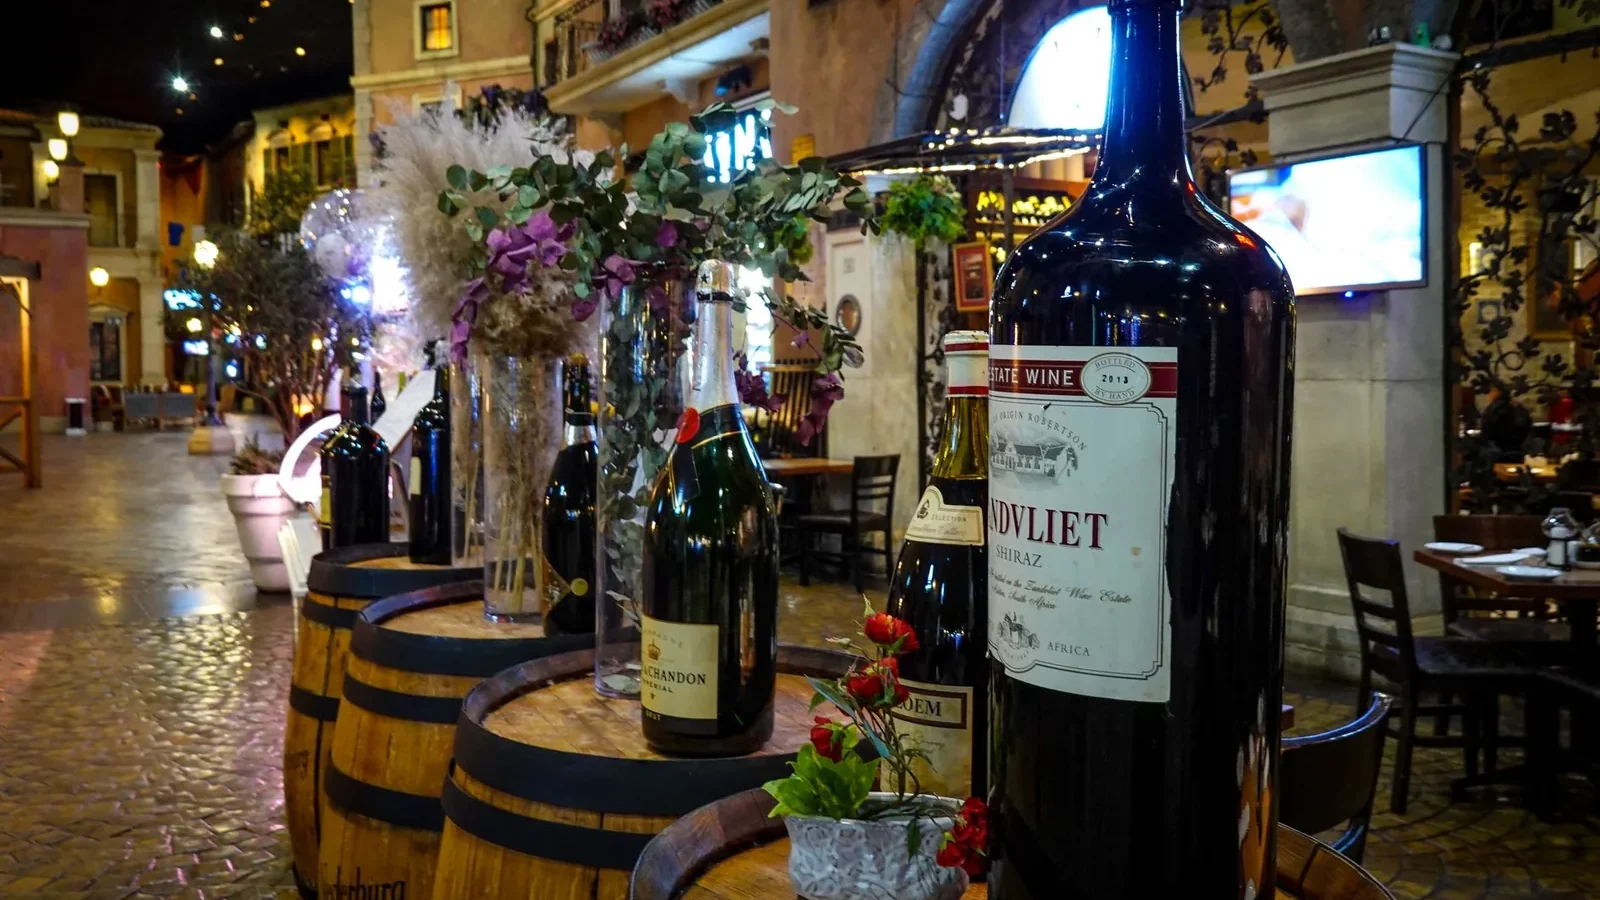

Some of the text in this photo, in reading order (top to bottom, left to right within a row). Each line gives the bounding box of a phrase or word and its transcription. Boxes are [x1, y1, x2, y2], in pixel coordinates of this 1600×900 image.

[1095, 358, 1136, 368] BOTTLED
[1026, 368, 1074, 386] WINE
[1102, 374, 1129, 384] 2013
[1110, 390, 1135, 400] HAND
[1028, 412, 1088, 451] ROBERTSON
[996, 544, 1042, 569] SHIRAZ
[1065, 586, 1093, 600] Wine
[1099, 589, 1133, 604] Estate
[1047, 641, 1090, 657] AFRICA
[648, 665, 707, 685] CHANDON
